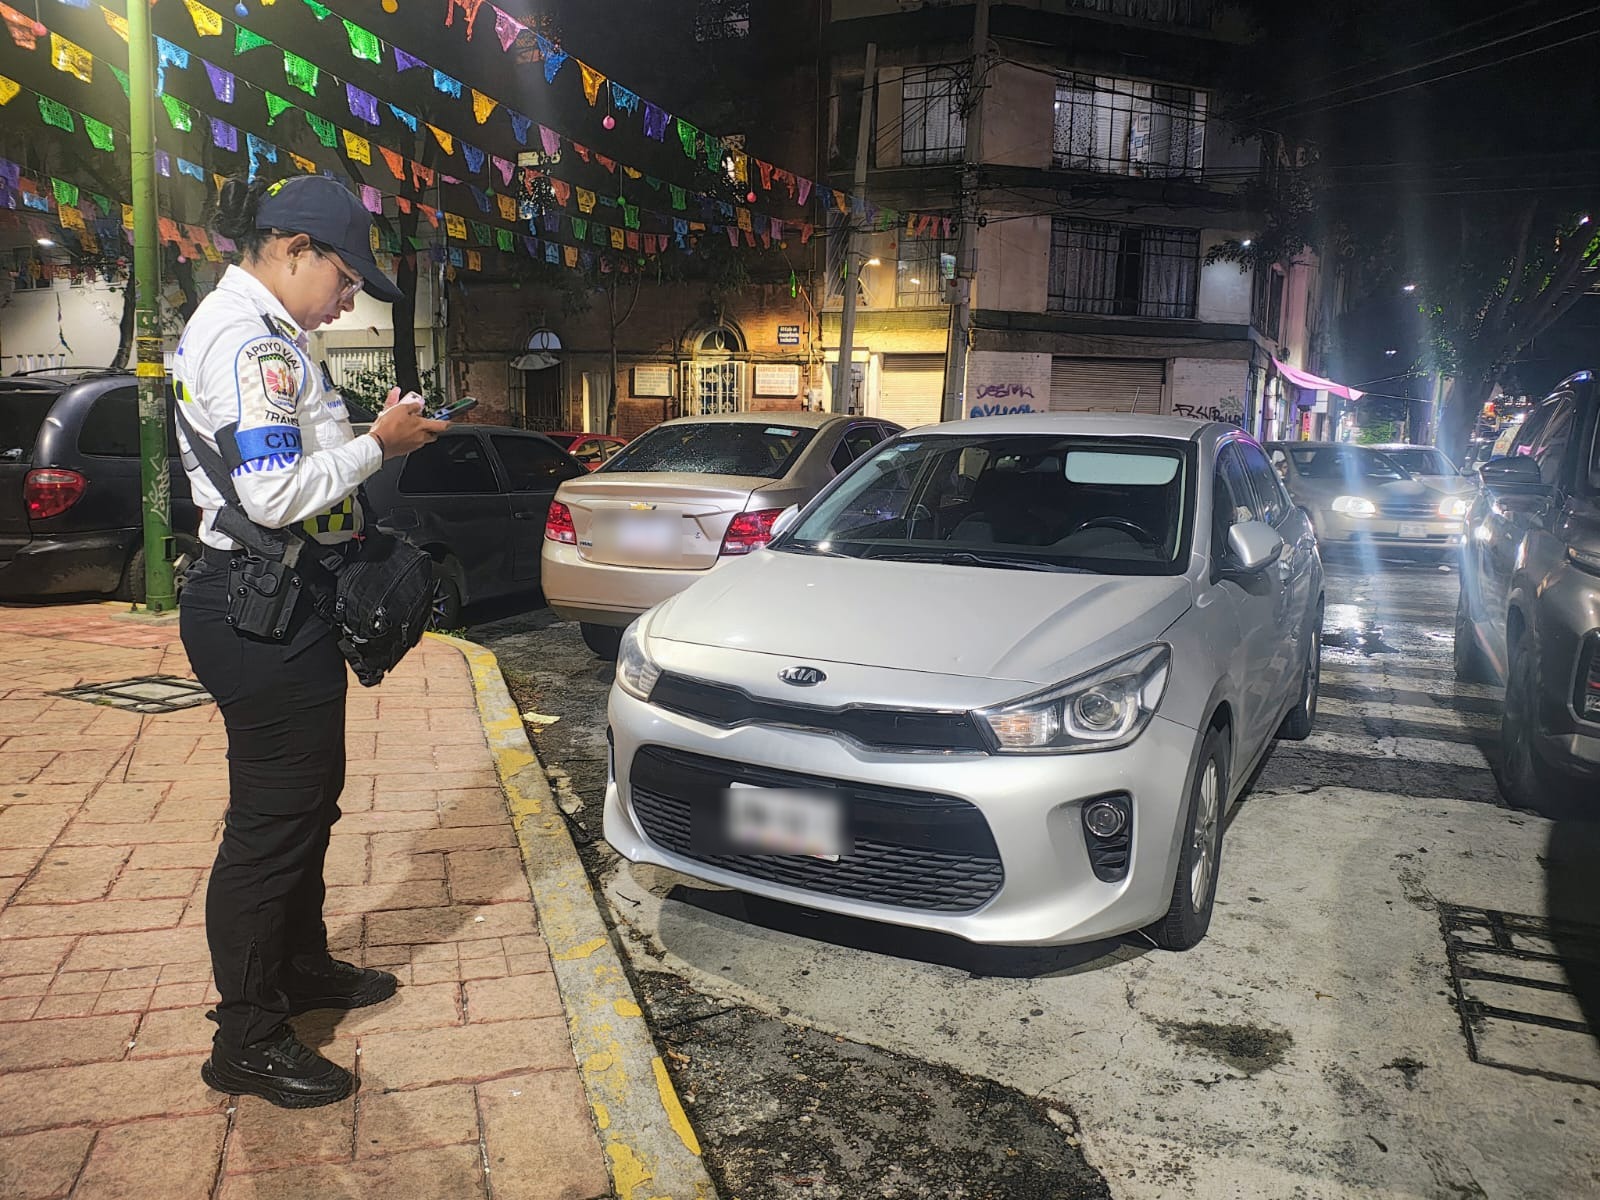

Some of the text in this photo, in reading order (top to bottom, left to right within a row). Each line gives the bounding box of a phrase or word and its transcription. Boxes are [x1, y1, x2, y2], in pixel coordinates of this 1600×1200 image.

[245, 342, 300, 371] APOYO VIAL
[265, 432, 302, 449] CD
[783, 667, 819, 683] KIA
